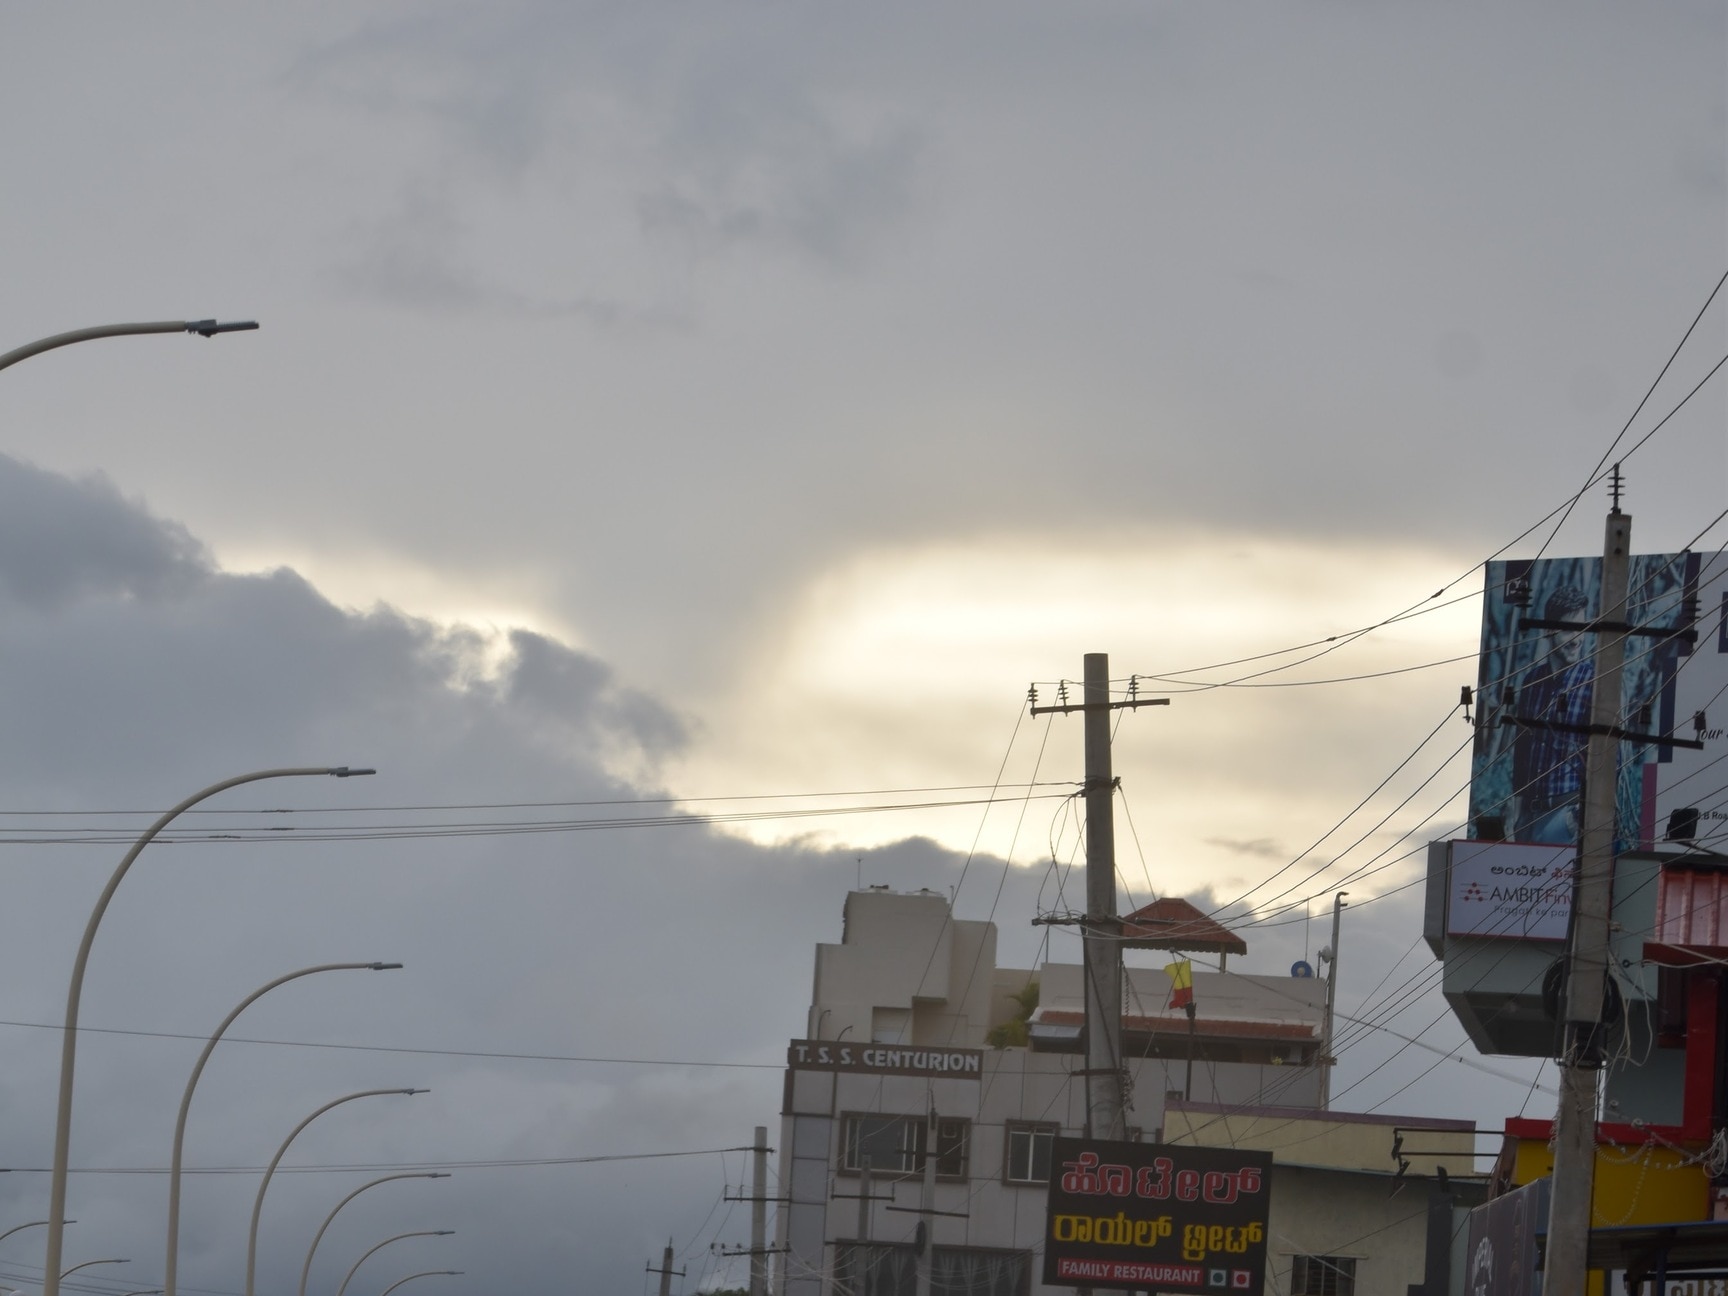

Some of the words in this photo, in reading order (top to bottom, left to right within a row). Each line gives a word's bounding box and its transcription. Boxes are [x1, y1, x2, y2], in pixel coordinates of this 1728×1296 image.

[796, 1045, 812, 1064] T.
[862, 1049, 979, 1073] CENTURION
[1053, 1211, 1173, 1248] ರಾಯಲ್
[1062, 1260, 1110, 1278] FAMILY
[1113, 1265, 1201, 1283] RESTAURANT
